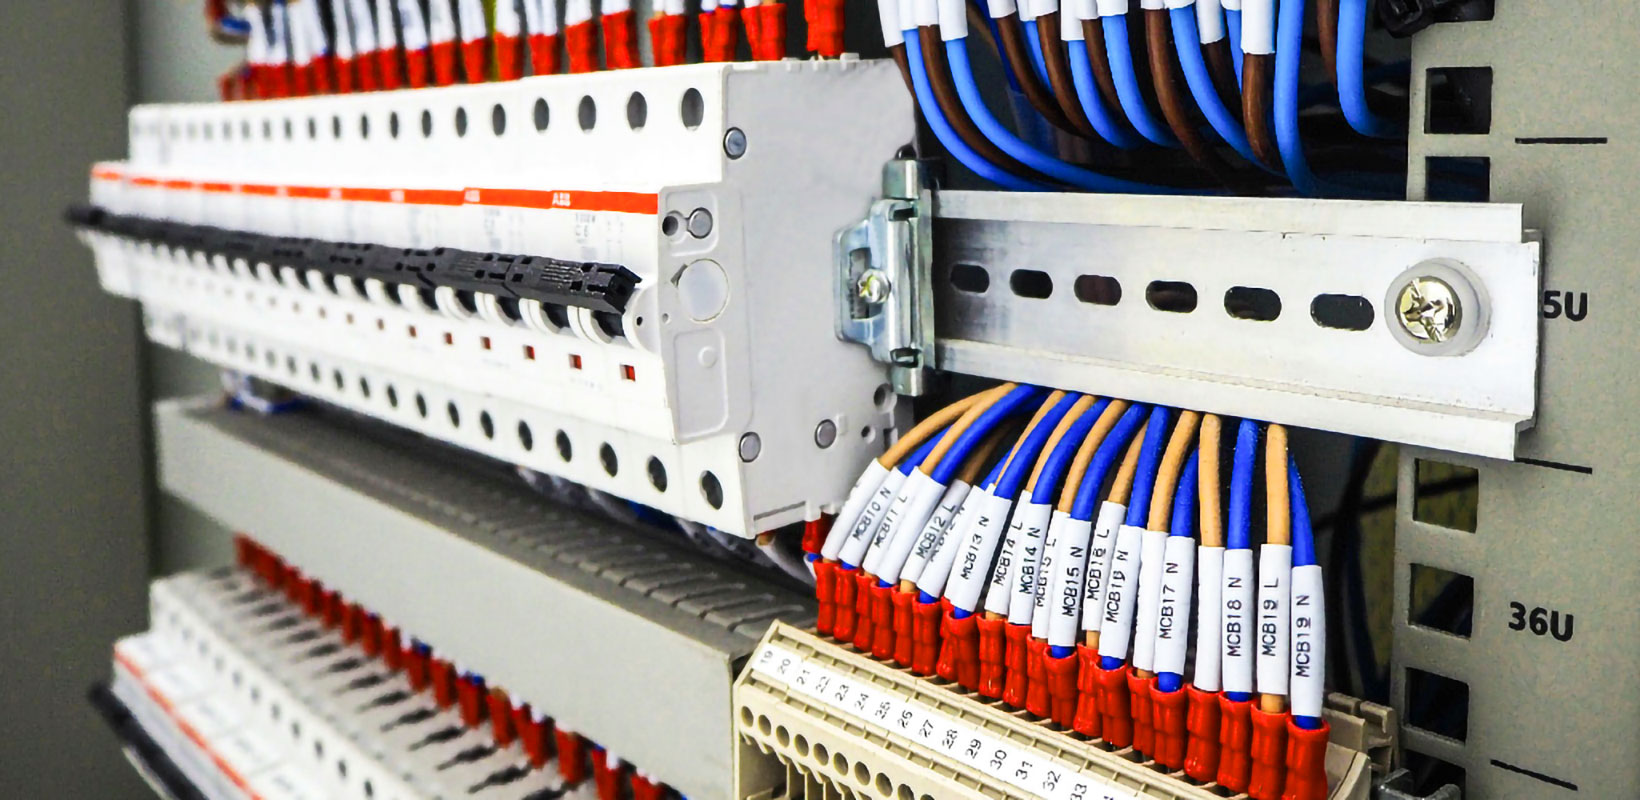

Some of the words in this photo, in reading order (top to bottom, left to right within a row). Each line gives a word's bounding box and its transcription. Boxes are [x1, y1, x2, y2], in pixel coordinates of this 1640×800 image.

[552, 191, 571, 207] ABB
[1543, 290, 1588, 322] 5U
[852, 501, 881, 541] MCB10
[879, 486, 891, 499] N
[873, 508, 899, 548] MCB11
[897, 495, 908, 503] L
[915, 516, 946, 559] MCB12
[941, 504, 957, 513] L
[1027, 527, 1041, 538] N
[1096, 529, 1110, 538] L
[960, 533, 983, 580] MCB13
[978, 515, 990, 527] N
[993, 537, 1016, 586] MCB14
[1010, 521, 1023, 531] L
[1018, 546, 1037, 595] MCB14
[1069, 546, 1084, 558] N
[1116, 550, 1129, 561] N
[1165, 562, 1179, 573] N
[1062, 567, 1080, 617] MCB15
[1227, 577, 1243, 588] N
[1263, 577, 1279, 588] L
[1296, 594, 1310, 606] N
[1159, 584, 1176, 639] MCB17
[1226, 599, 1243, 657] MCB18
[1261, 599, 1278, 657] MCB19
[1508, 601, 1574, 642] 36U
[1295, 617, 1311, 678] MCB19
[760, 650, 773, 664] 19
[777, 658, 791, 675] 20
[796, 669, 810, 685] 21
[815, 676, 831, 693] 22
[834, 684, 850, 701] 23
[854, 693, 870, 710] 24
[918, 719, 934, 738] 27
[942, 729, 958, 749] 28
[964, 738, 982, 759] 29
[989, 749, 1007, 770] 30
[1015, 760, 1033, 780] 31
[1042, 770, 1061, 791] 32
